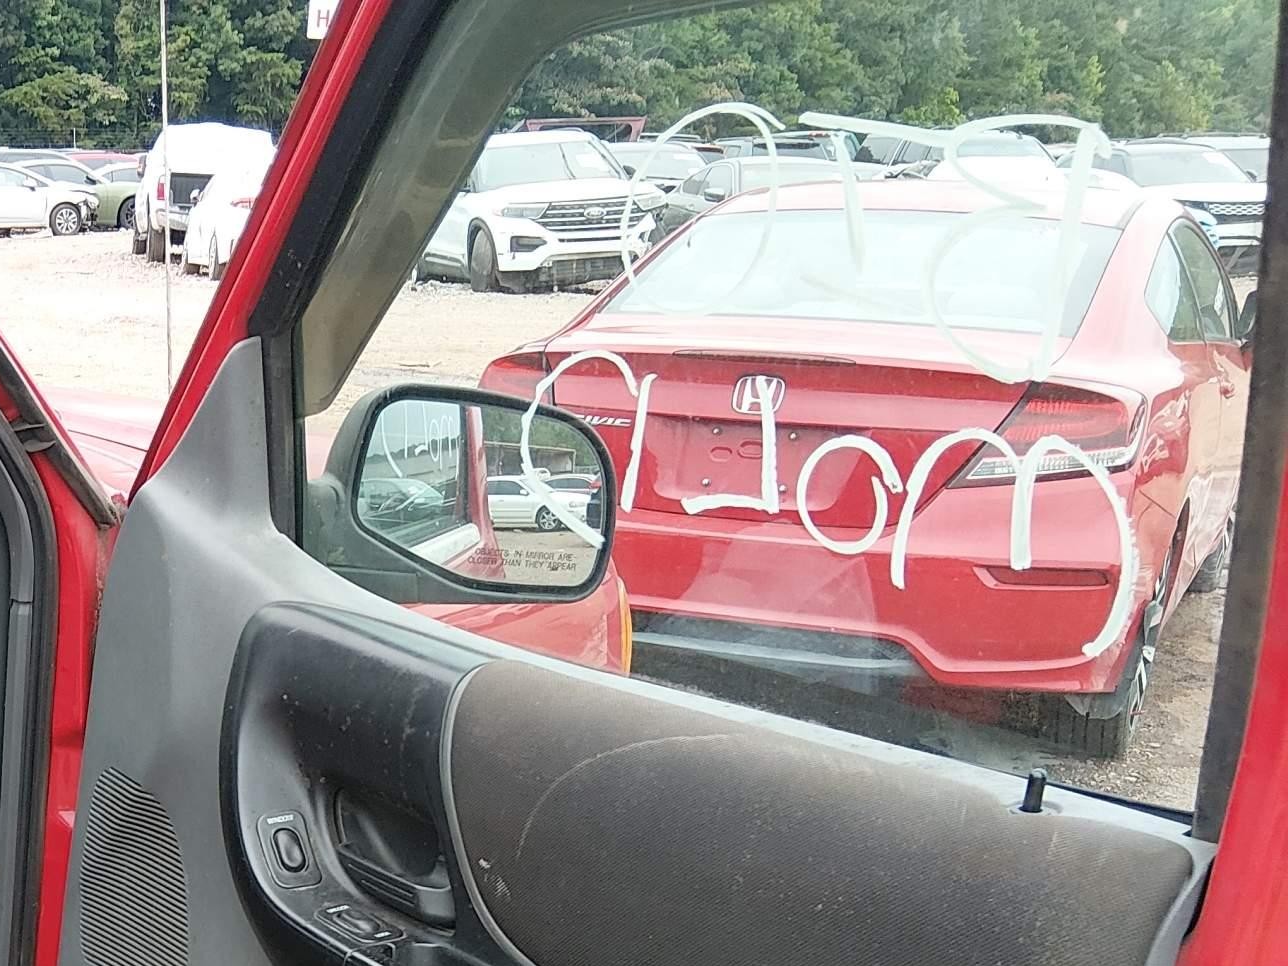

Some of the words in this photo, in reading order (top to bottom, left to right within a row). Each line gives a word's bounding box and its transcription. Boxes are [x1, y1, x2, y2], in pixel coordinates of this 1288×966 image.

[474, 547, 509, 558] OBJECTS
[514, 549, 522, 558] IN
[525, 550, 556, 560] MIRROR
[467, 556, 497, 565] CLOSER
[501, 558, 521, 567] THAN
[525, 560, 544, 568] THEY
[546, 561, 577, 572] APPEAR
